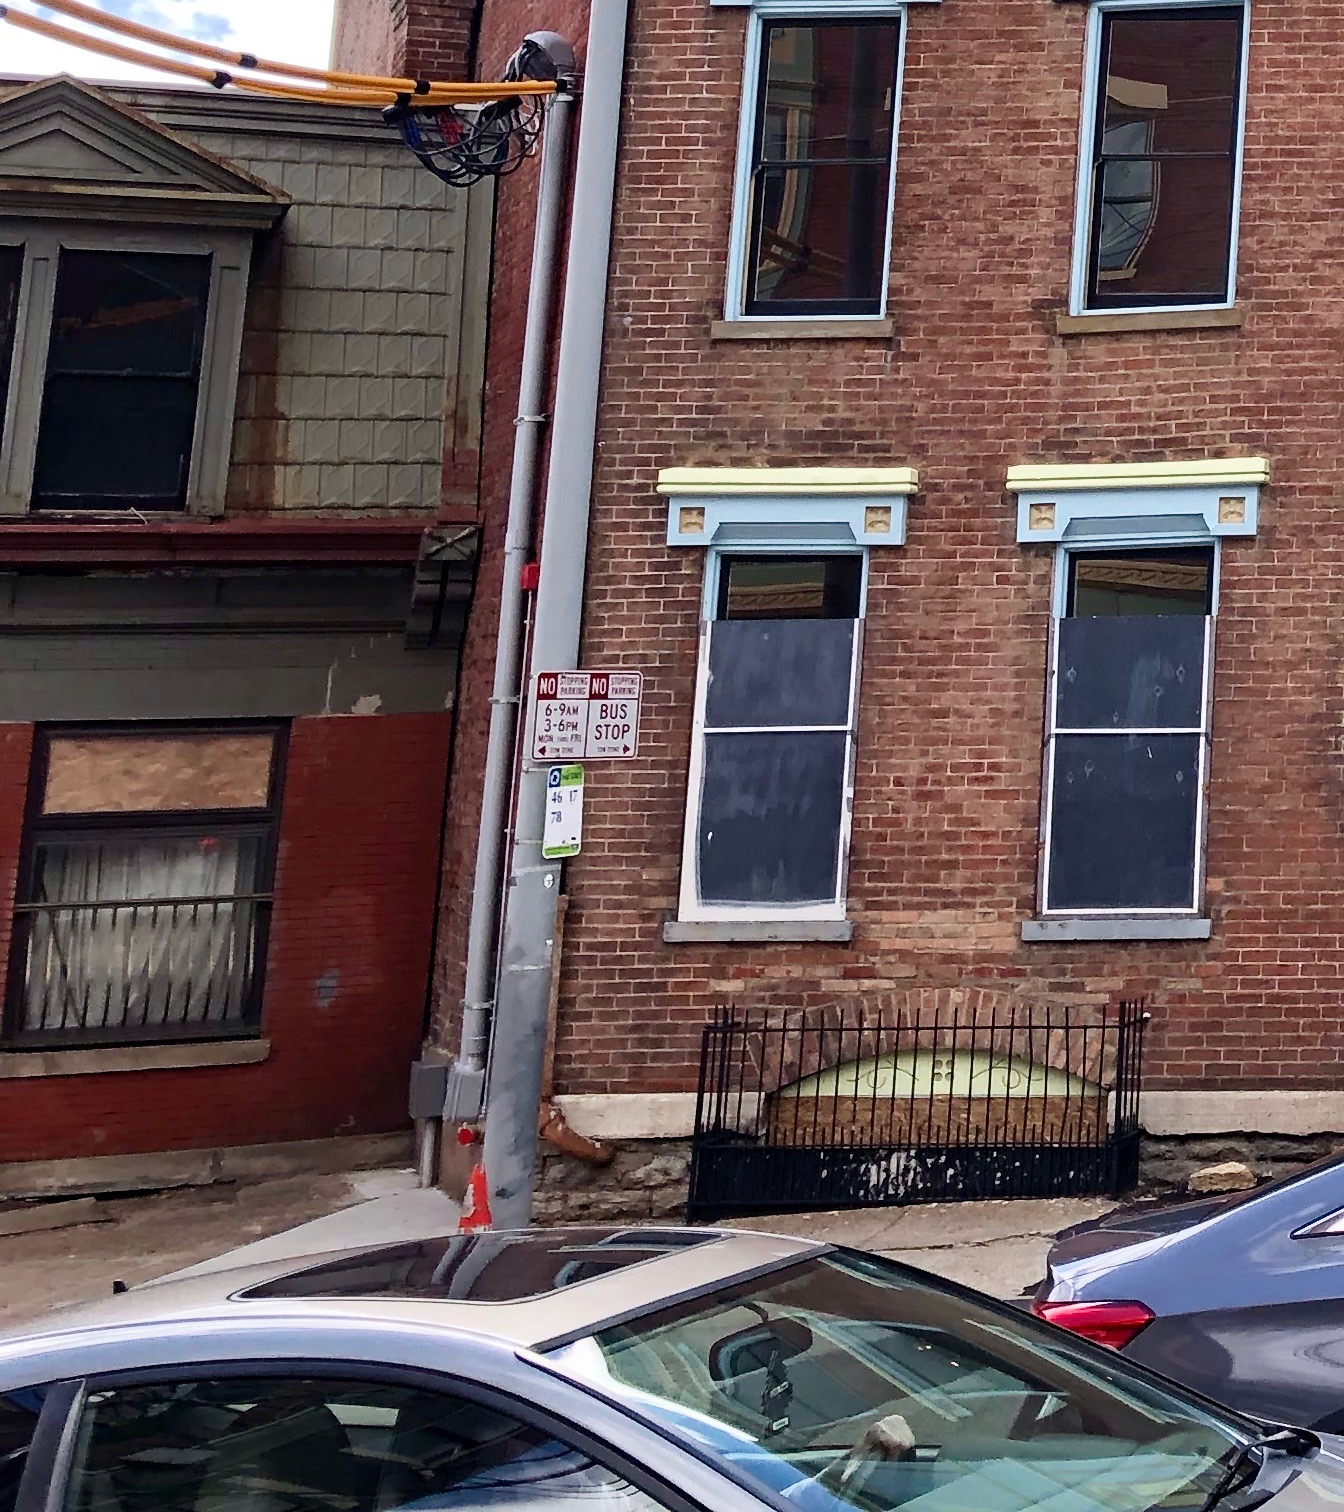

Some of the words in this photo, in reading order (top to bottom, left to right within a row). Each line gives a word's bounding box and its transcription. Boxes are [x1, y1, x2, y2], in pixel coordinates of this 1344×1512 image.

[539, 677, 556, 695] NO
[559, 676, 589, 686] STOPPING
[591, 678, 607, 695] NO
[610, 676, 638, 686] STOPPING
[560, 687, 587, 696] PARKING
[611, 687, 637, 696] PARKING
[599, 703, 628, 720] BUS
[594, 723, 631, 741] STOP
[551, 790, 563, 804] 46
[550, 810, 562, 824] 78
